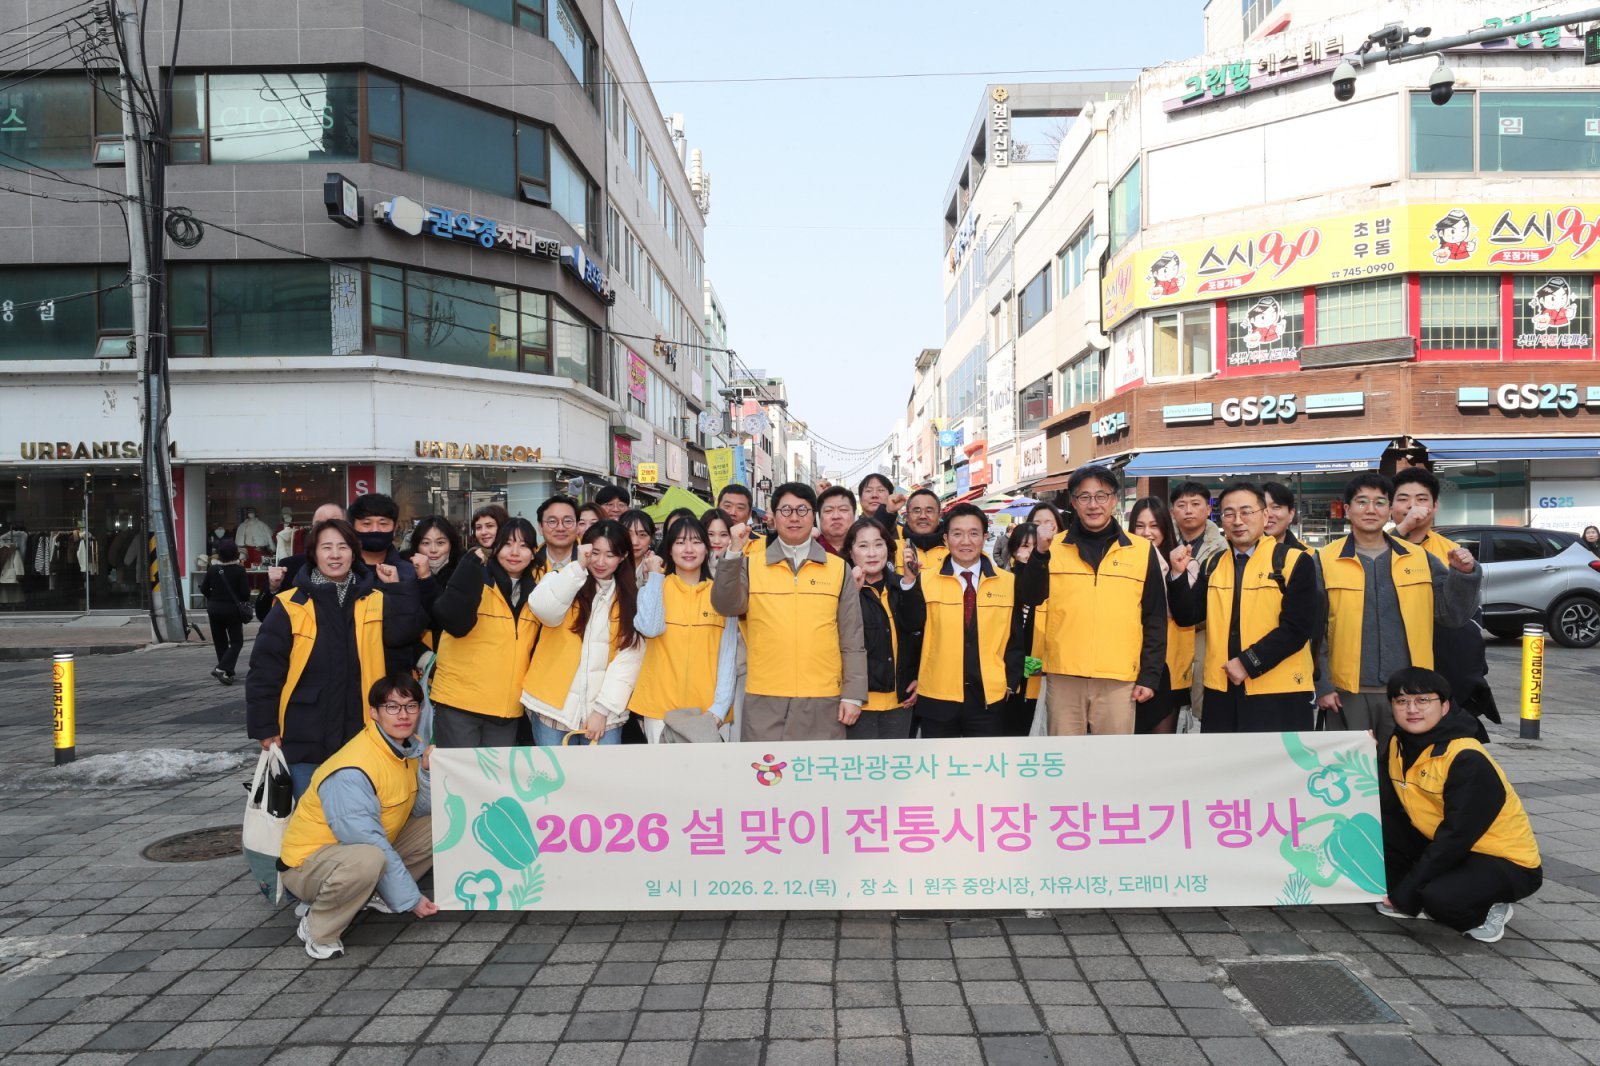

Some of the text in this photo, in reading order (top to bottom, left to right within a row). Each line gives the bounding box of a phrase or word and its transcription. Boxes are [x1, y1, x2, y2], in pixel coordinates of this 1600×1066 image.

[1501, 118, 1522, 134] 임
[1354, 217, 1391, 238] 초밥
[1354, 239, 1390, 258] 우동
[1502, 251, 1540, 261] 포장가능
[1343, 262, 1394, 278] 745-0990
[1207, 277, 1242, 290] 포장가능
[1497, 383, 1578, 410] GS25
[1220, 394, 1297, 423] GS25
[20, 440, 178, 460] URBANISM
[414, 440, 542, 462] URBANISOM
[1539, 496, 1574, 508] GS25
[1530, 655, 1542, 704] 금연거리
[791, 752, 1066, 782] 한국관광공사 노-사 공동
[536, 797, 1307, 856] 2026 설 맞이 전통시장 장보기 행사
[646, 879, 683, 898] 일시
[860, 878, 899, 896] 장소
[924, 876, 957, 895] 원주
[962, 875, 1035, 896] 중앙시장,
[1040, 874, 1113, 896] 자유시장,
[1118, 874, 1169, 894] 도래미
[1174, 874, 1208, 894] 시장
